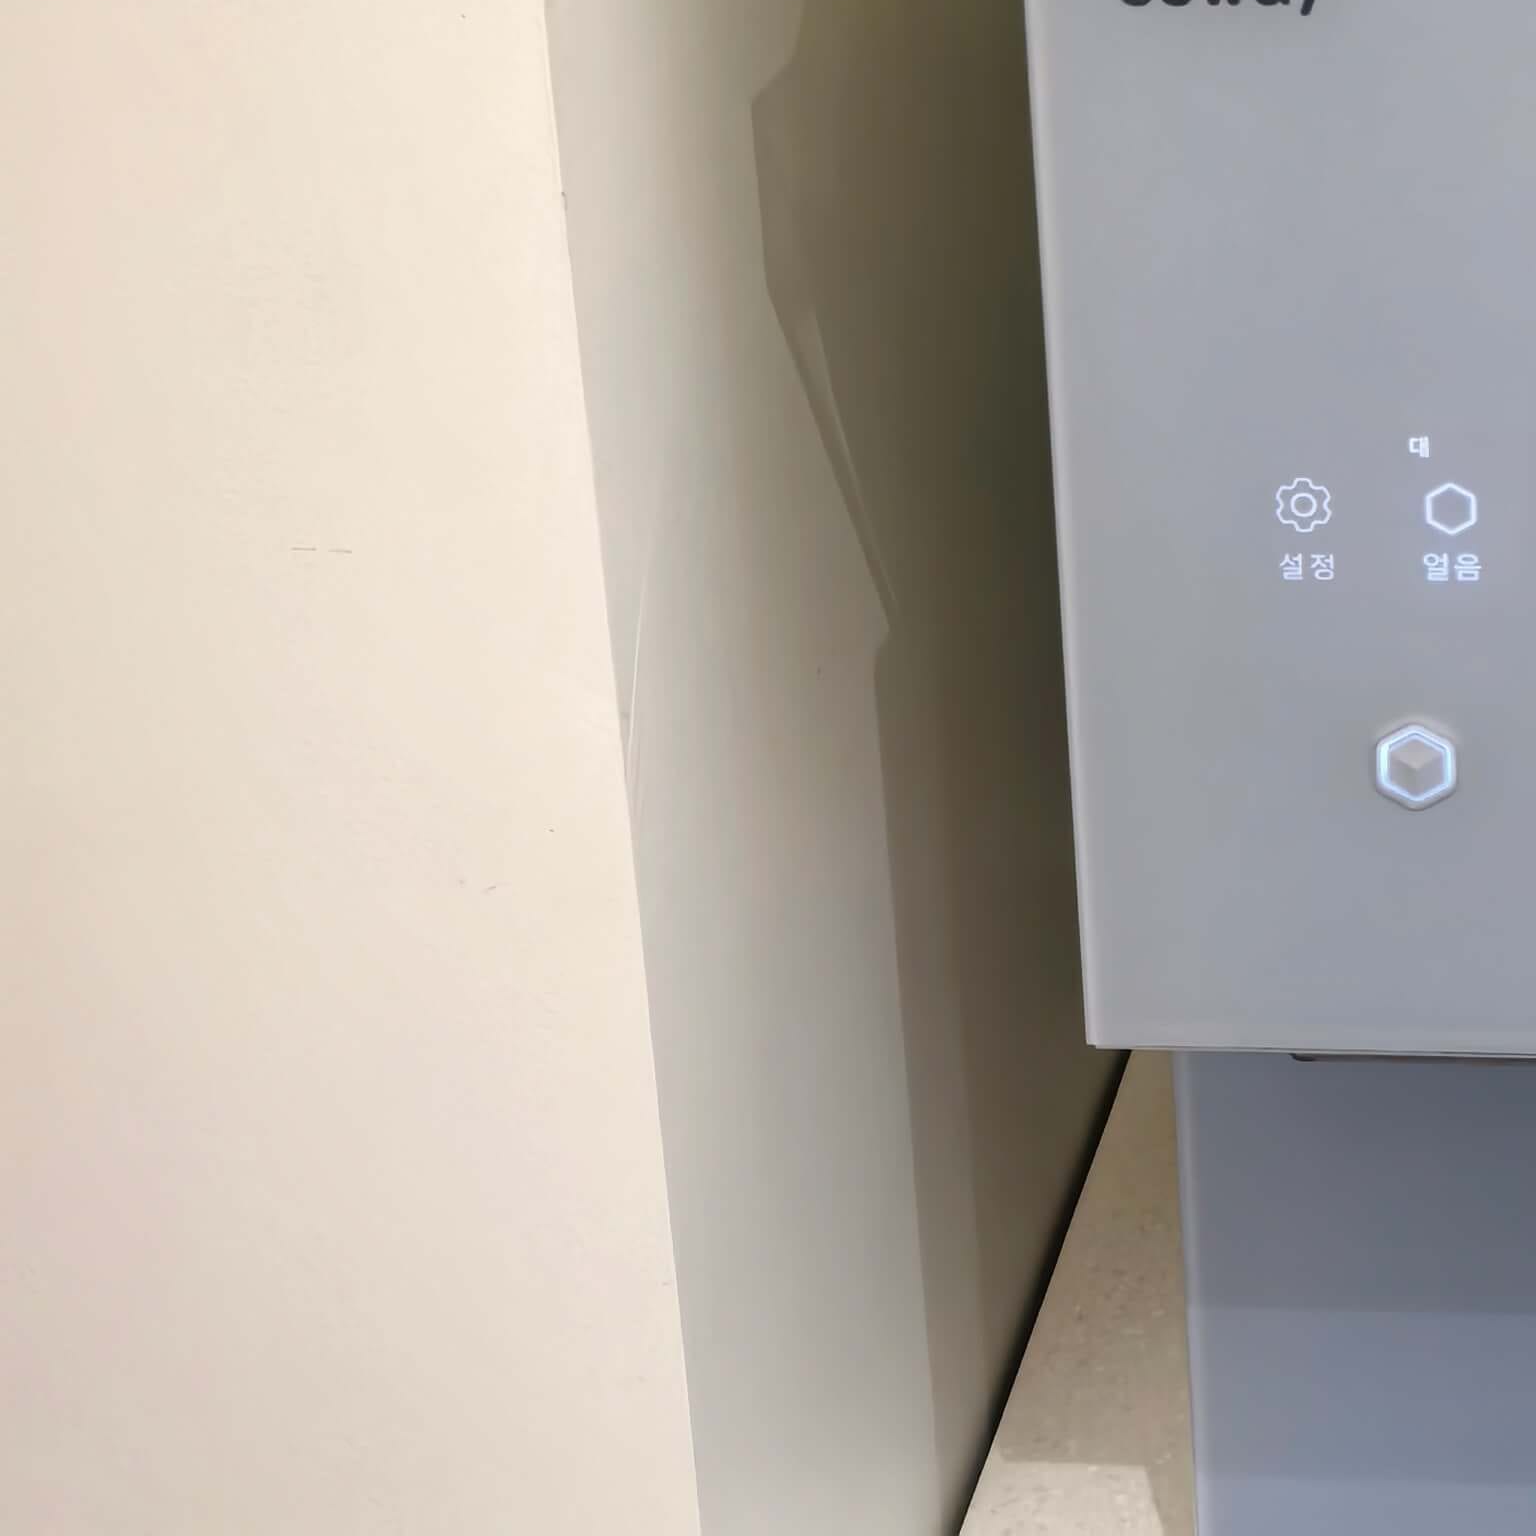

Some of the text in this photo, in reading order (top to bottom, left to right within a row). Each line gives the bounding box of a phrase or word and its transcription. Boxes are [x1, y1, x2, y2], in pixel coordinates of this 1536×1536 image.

[1408, 435, 1431, 459] 대
[1279, 552, 1336, 581] 설정
[1422, 552, 1483, 583] 얼음
